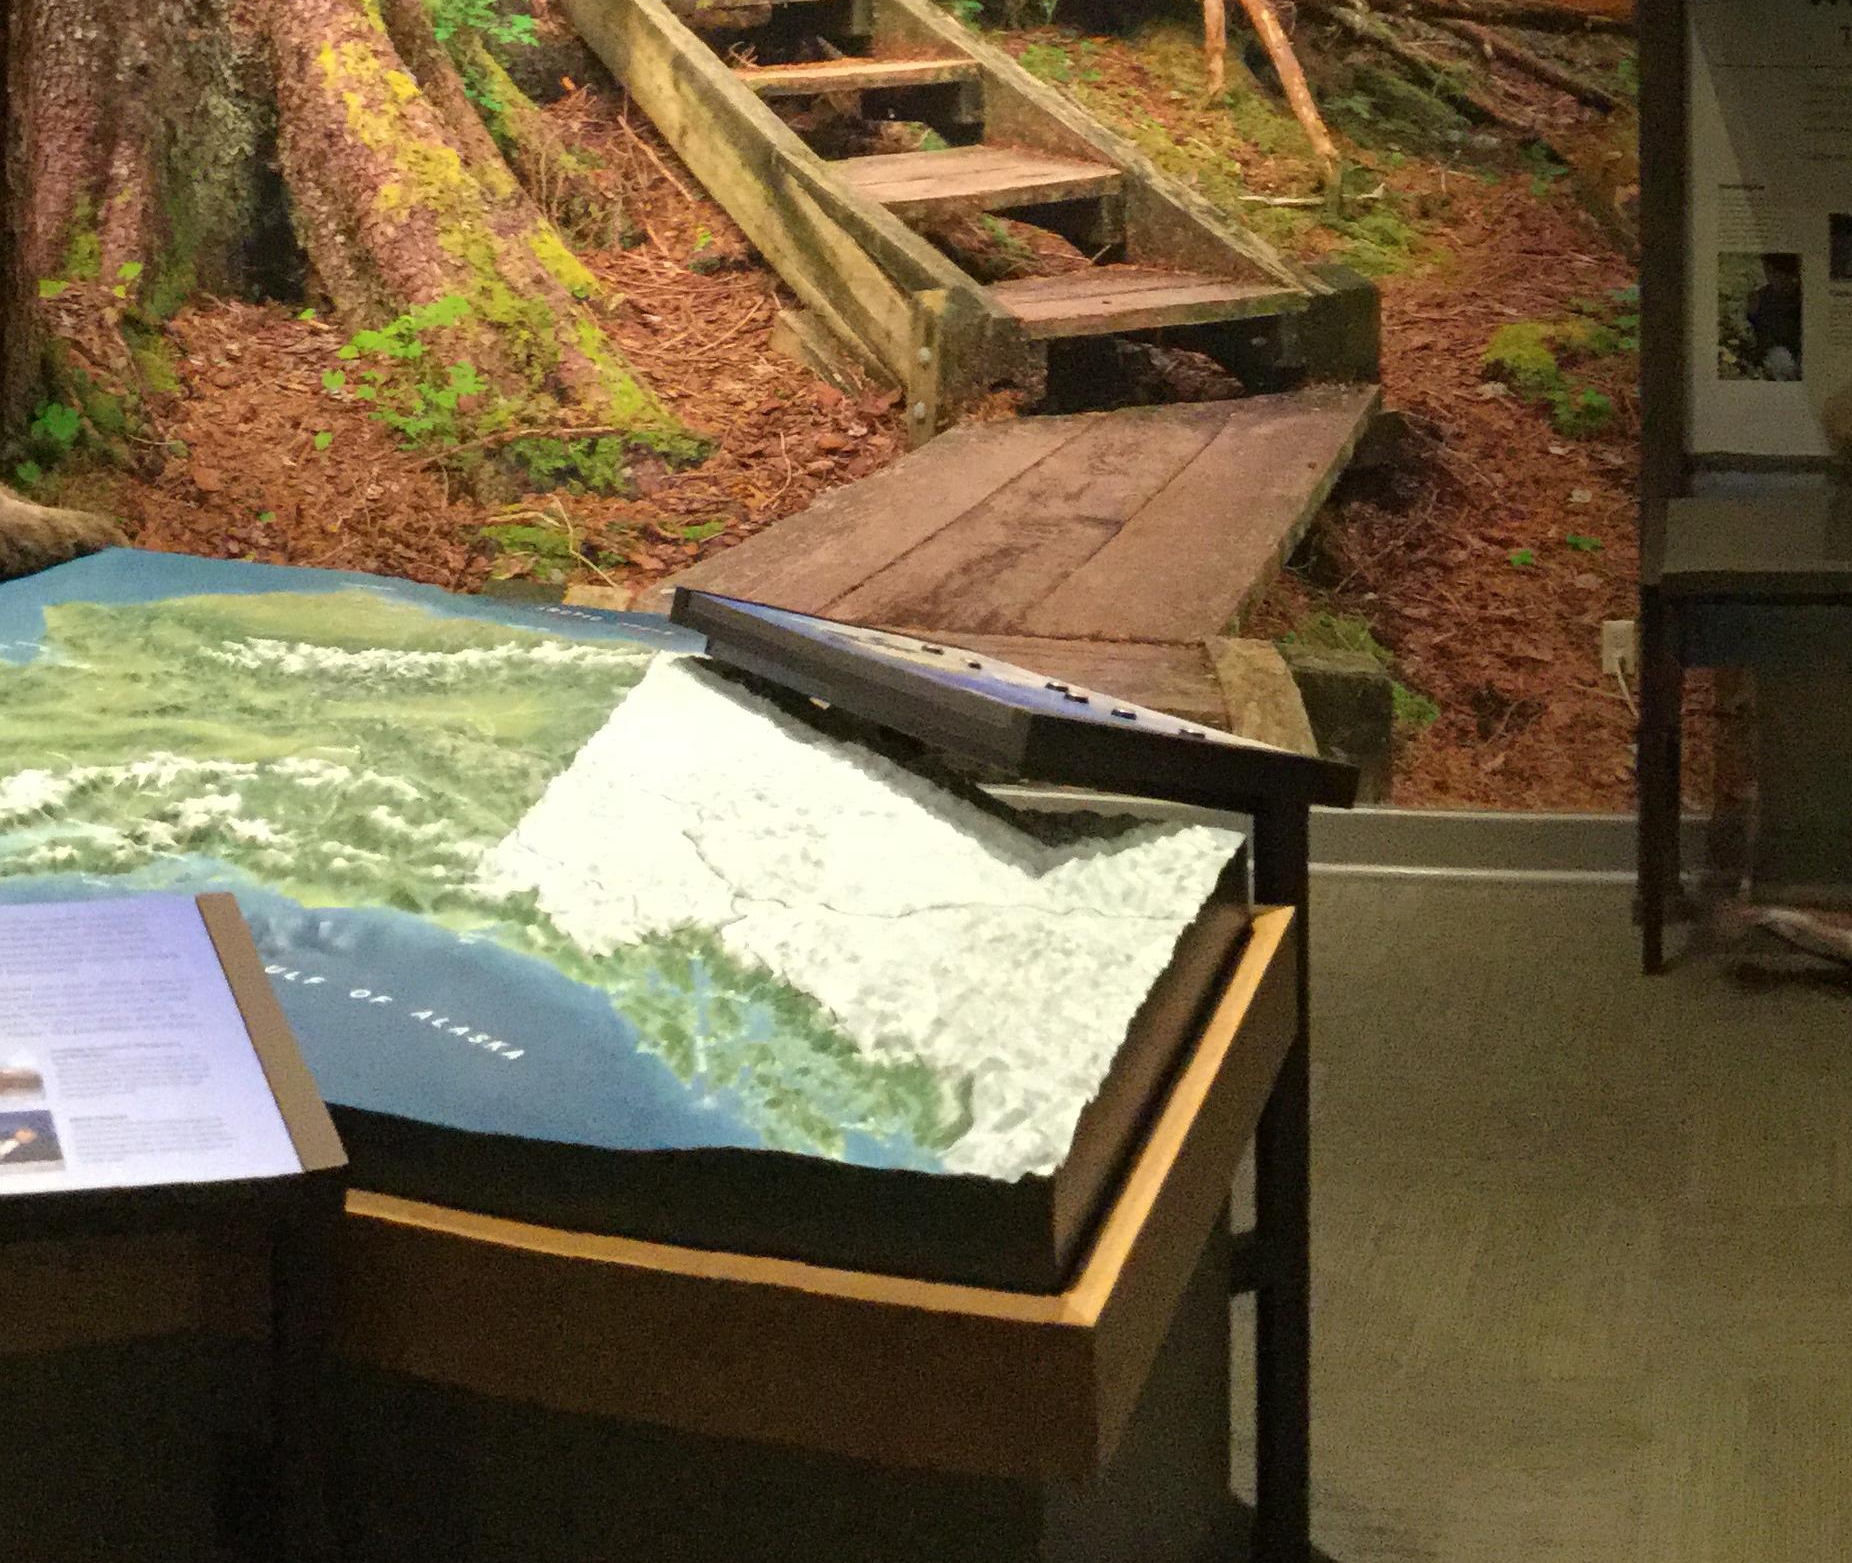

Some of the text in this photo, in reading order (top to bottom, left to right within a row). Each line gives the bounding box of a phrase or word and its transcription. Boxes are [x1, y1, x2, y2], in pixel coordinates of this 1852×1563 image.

[264, 964, 525, 1061] ULF OF ALASKA
